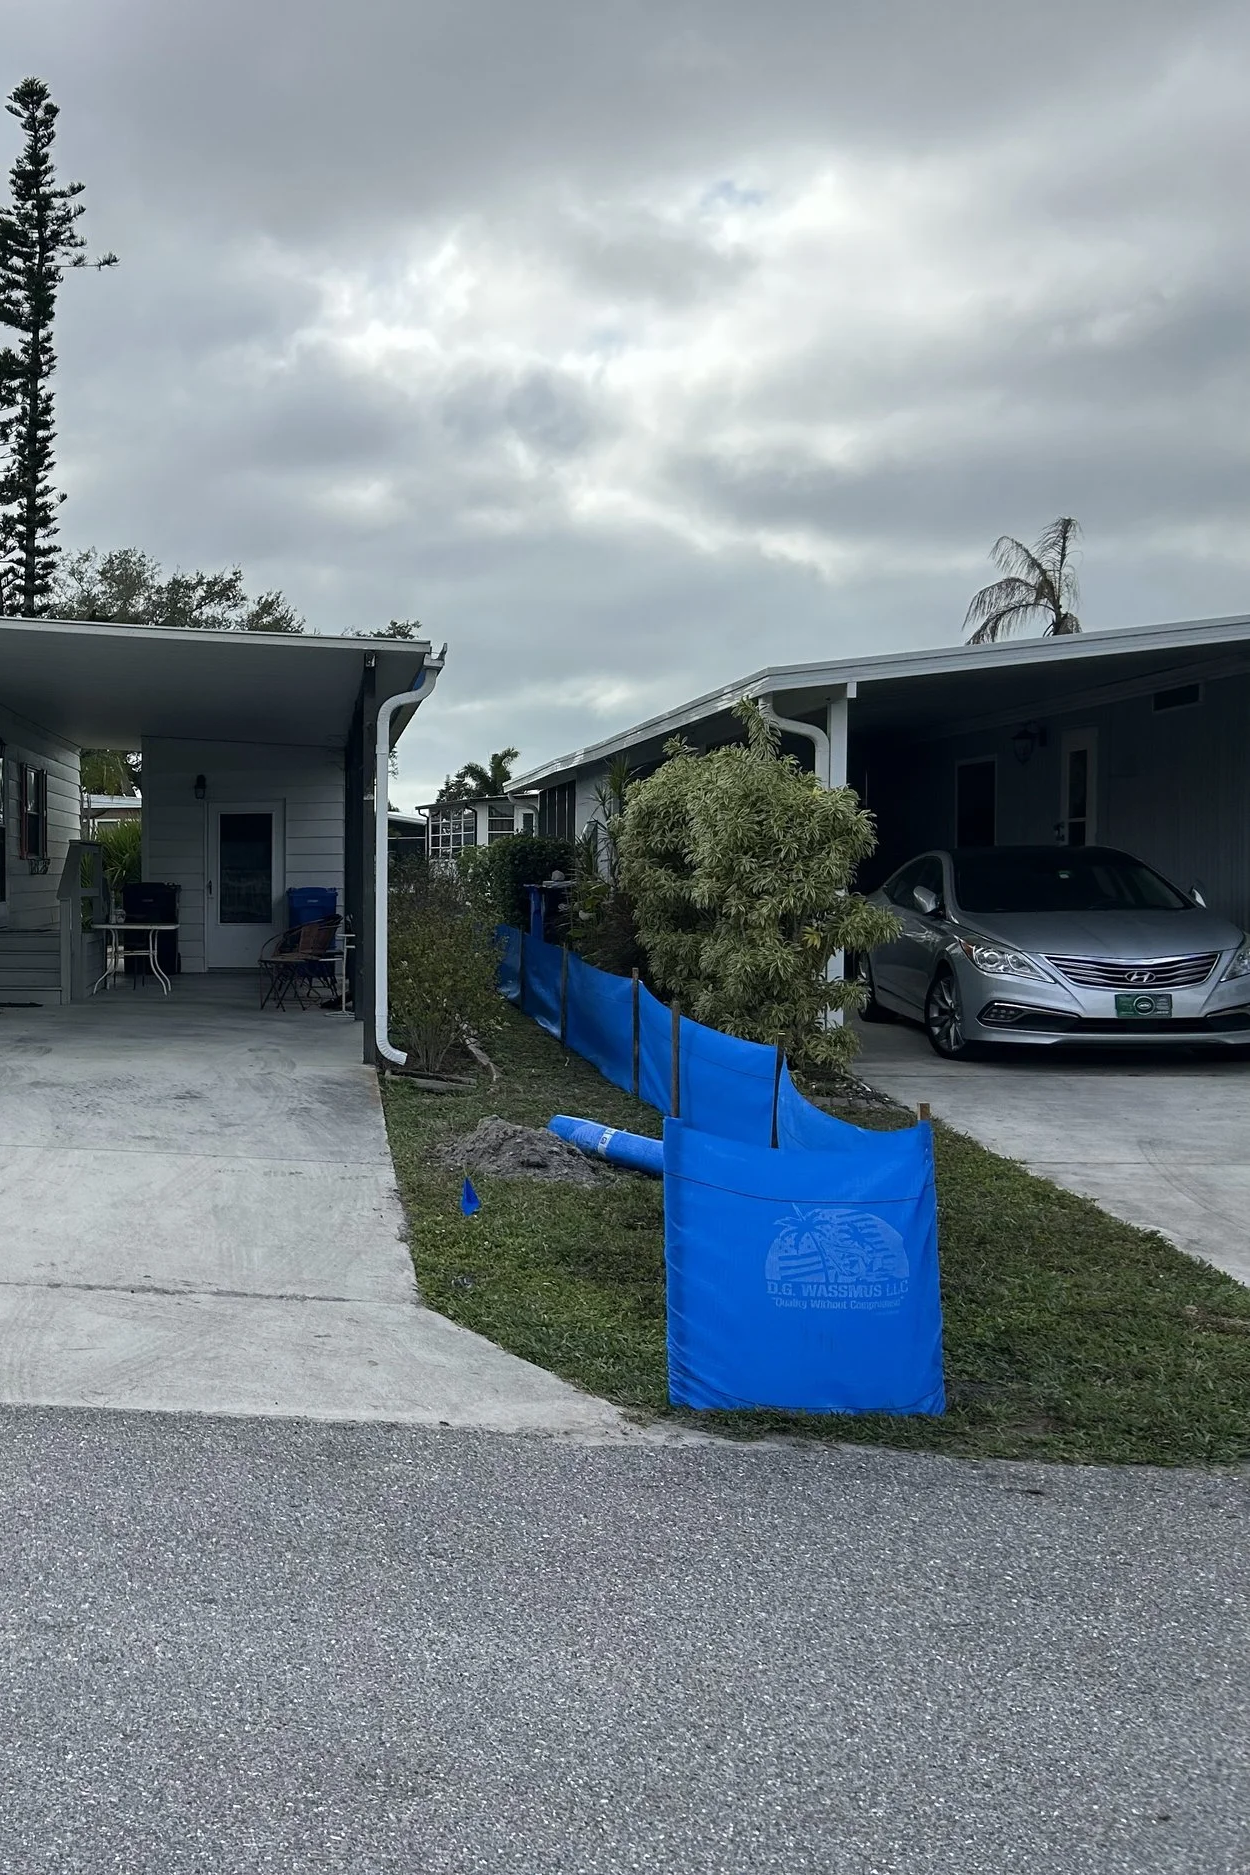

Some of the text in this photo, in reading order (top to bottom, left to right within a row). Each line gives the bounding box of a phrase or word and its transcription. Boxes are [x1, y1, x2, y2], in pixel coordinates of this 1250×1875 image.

[766, 1279, 909, 1298] D.G. WASSMUS LLC
[810, 1298, 848, 1309] Without
